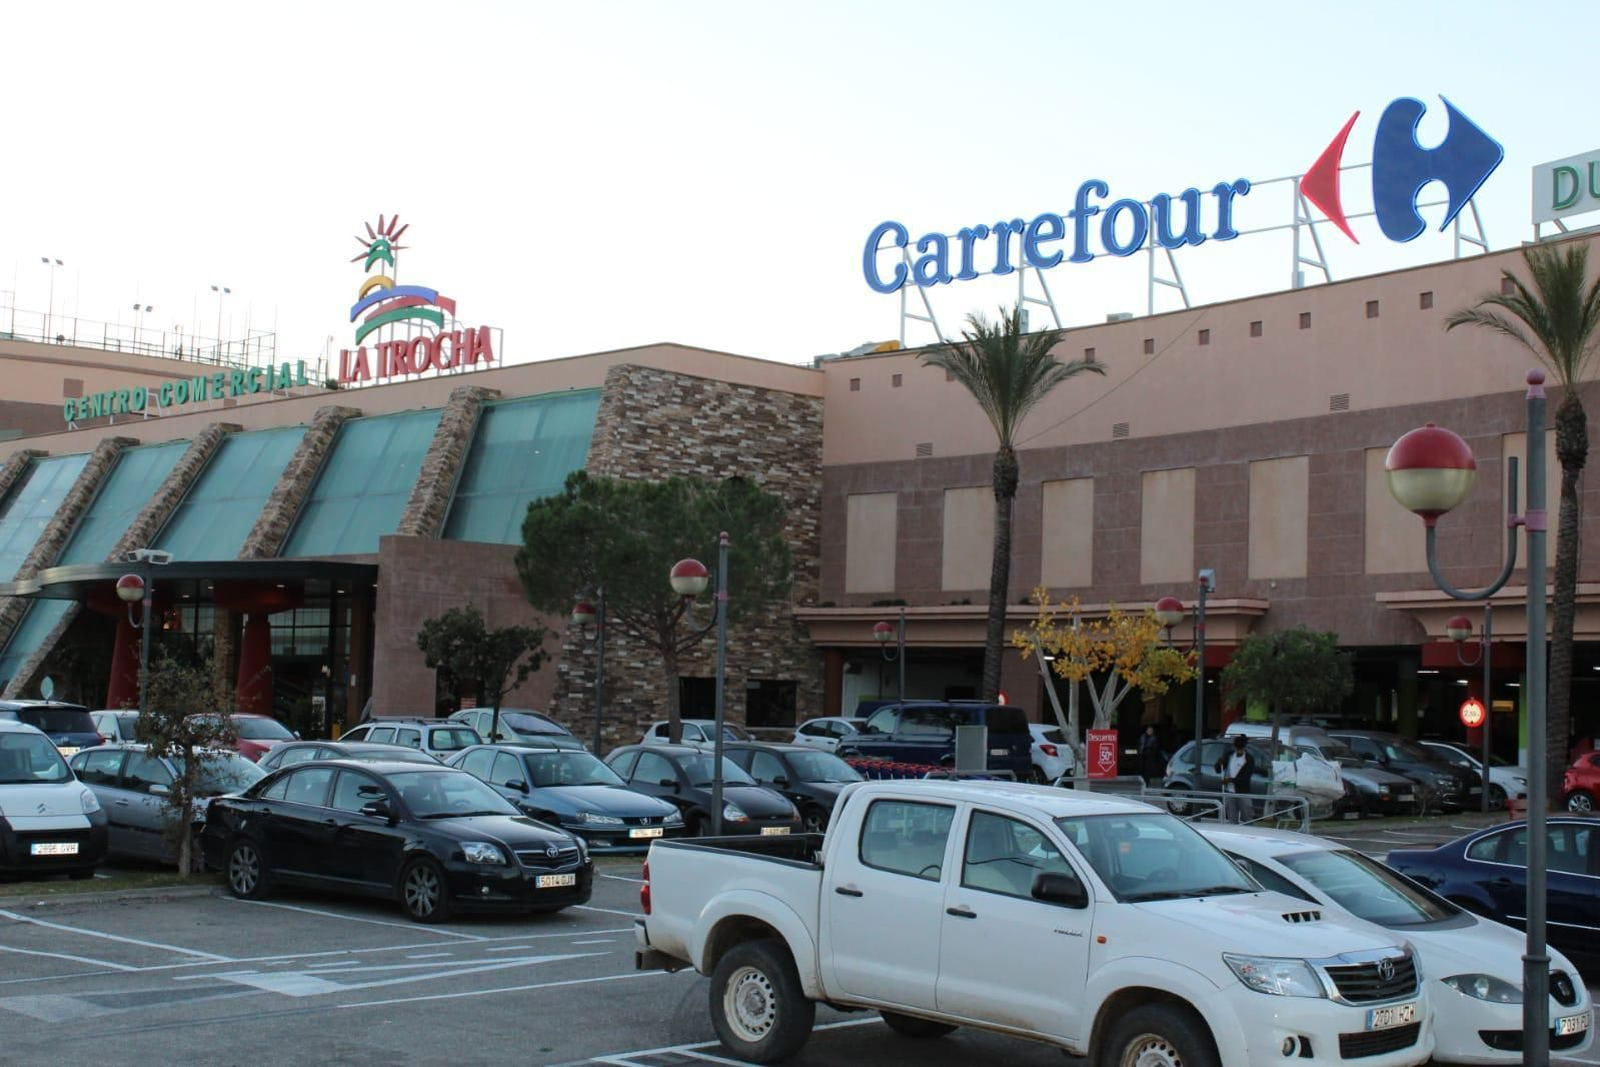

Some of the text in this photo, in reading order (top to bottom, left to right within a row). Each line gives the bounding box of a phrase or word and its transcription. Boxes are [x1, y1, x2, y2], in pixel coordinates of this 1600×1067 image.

[863, 179, 1251, 294] Carrefour
[338, 325, 494, 383] LA TROCHA
[64, 360, 309, 422] CENTRO COMERCIAL
